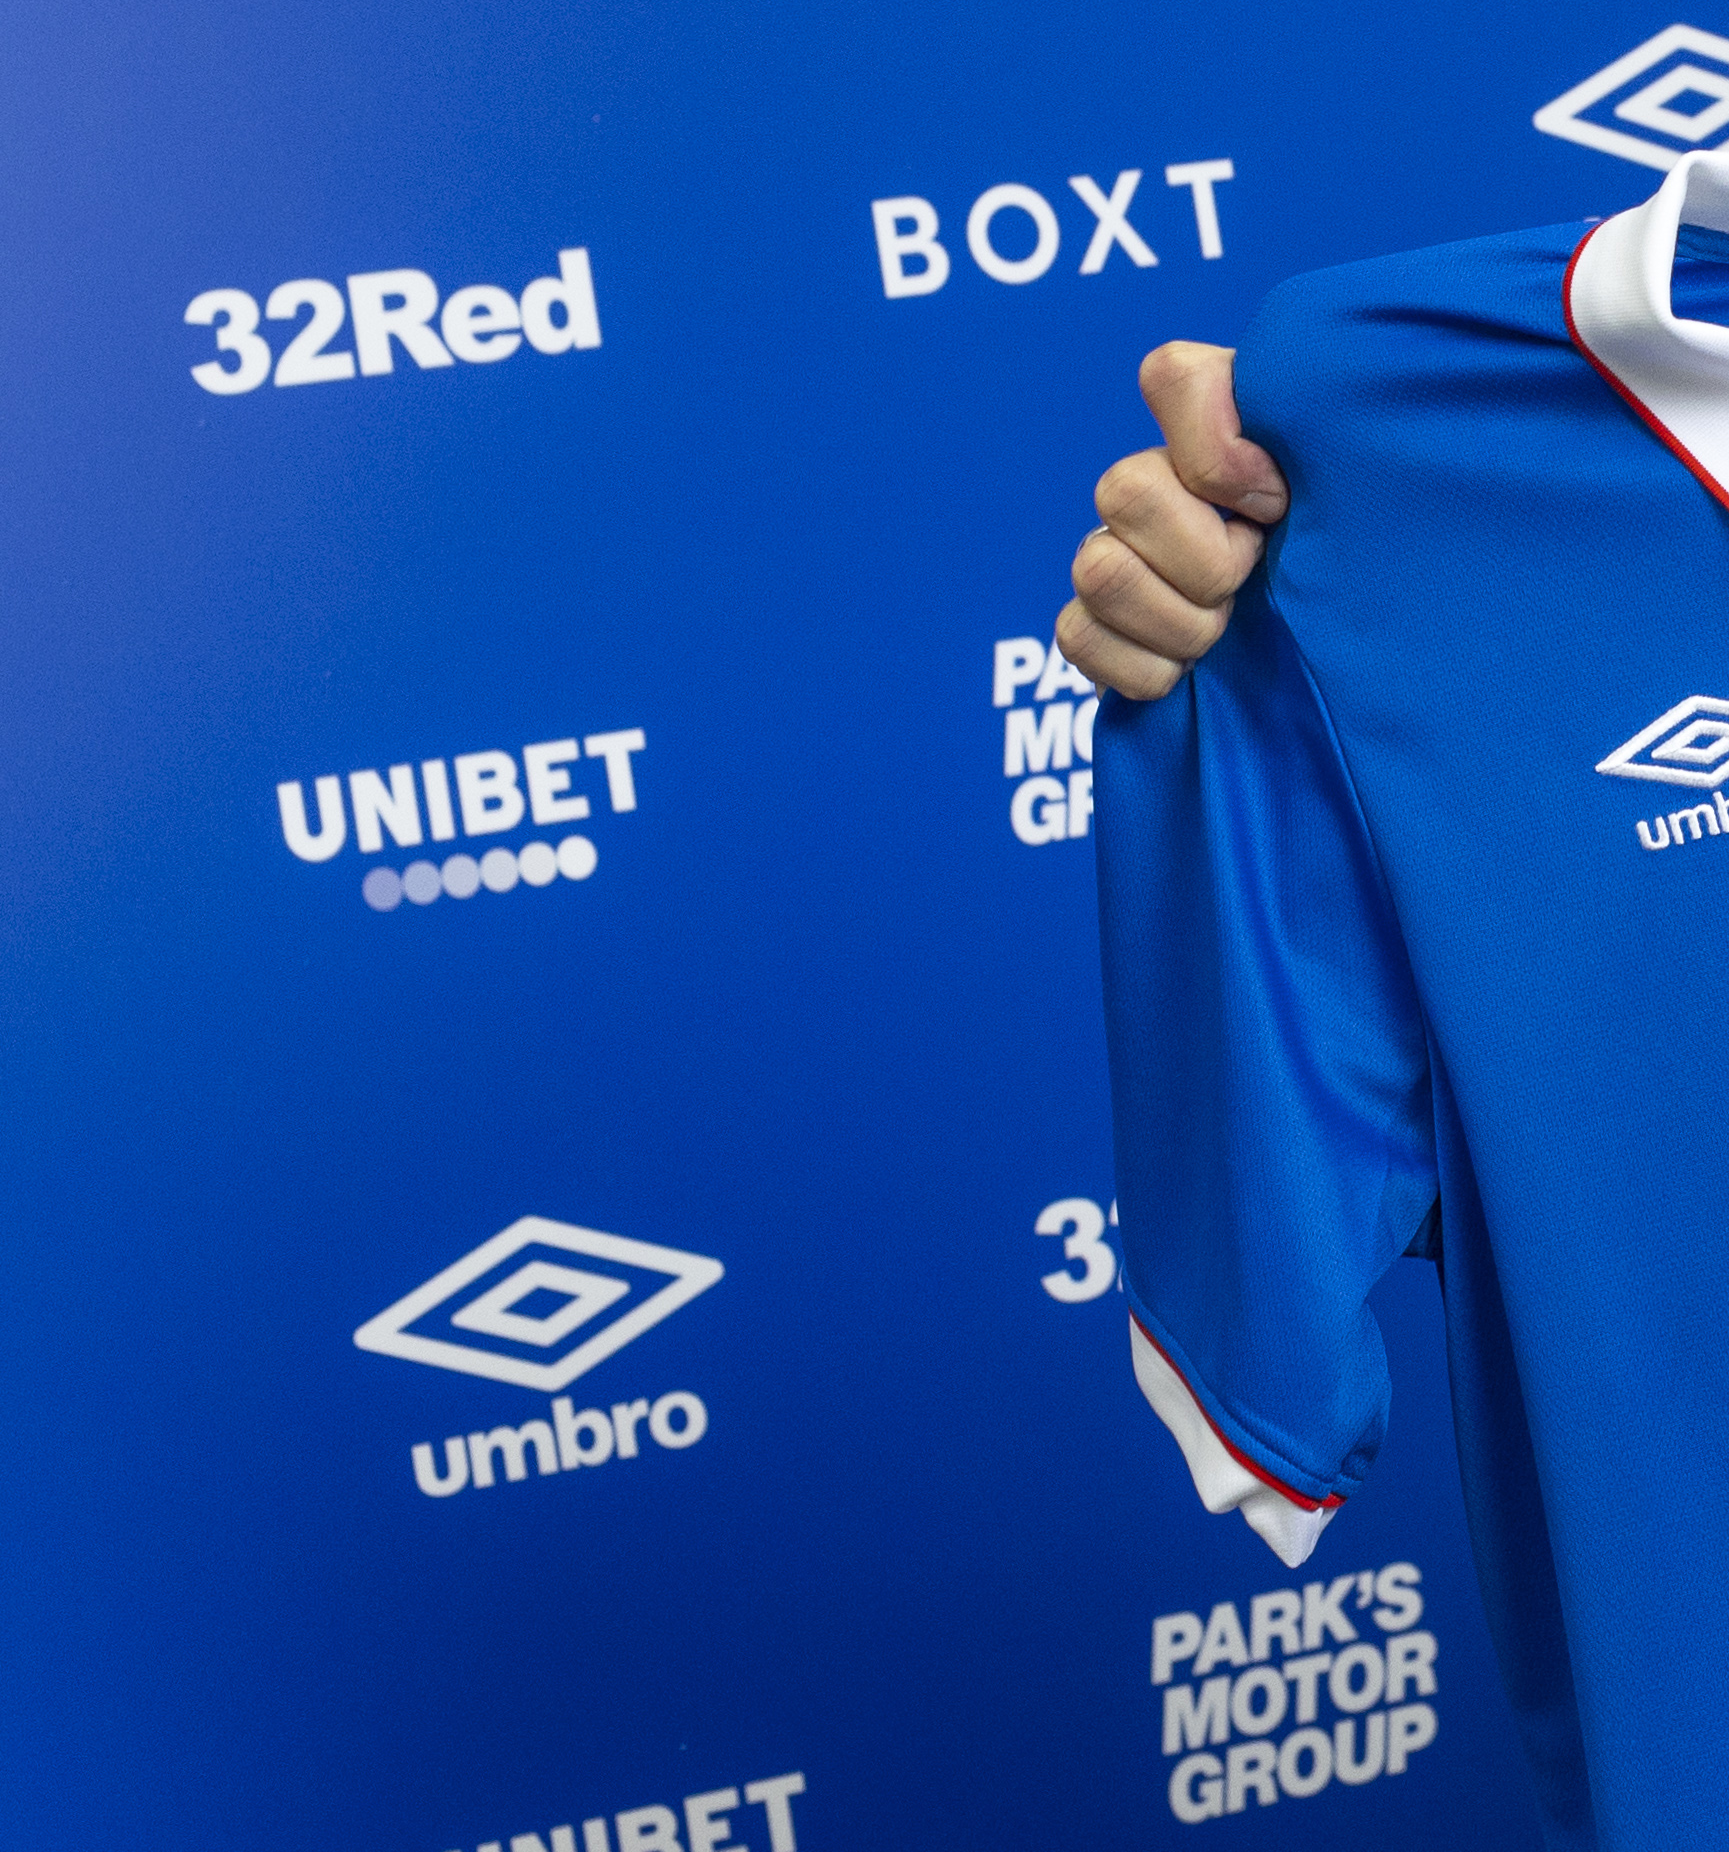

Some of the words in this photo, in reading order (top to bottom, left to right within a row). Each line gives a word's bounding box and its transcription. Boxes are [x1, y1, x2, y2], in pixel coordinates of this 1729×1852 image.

[871, 158, 1235, 299] BOXT
[183, 246, 602, 396] 32Red
[276, 728, 646, 862] UNIBET
[411, 1391, 708, 1498] umbro
[1162, 1630, 1438, 1756] MOTOR
[1167, 1702, 1439, 1825] GROUP
